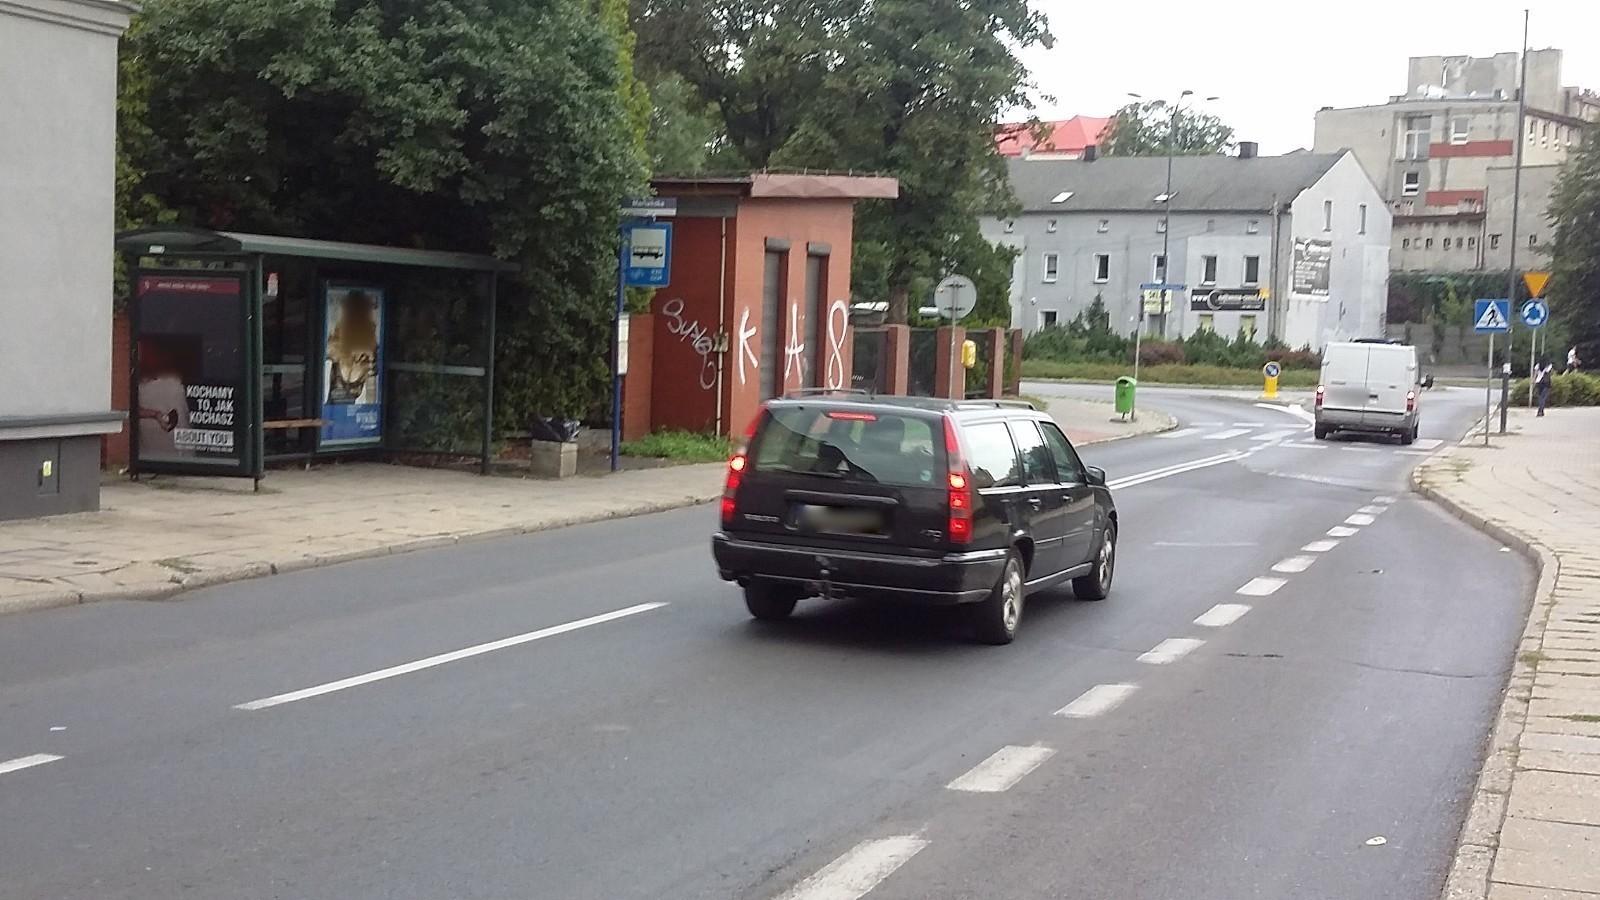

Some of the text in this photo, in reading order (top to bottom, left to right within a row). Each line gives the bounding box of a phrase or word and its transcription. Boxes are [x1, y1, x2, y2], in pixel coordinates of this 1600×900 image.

[186, 384, 234, 399] KOCHAMY
[197, 398, 234, 413] TO, JAK
[189, 410, 234, 426] KOCHASZ
[175, 430, 207, 444] ABOUT
